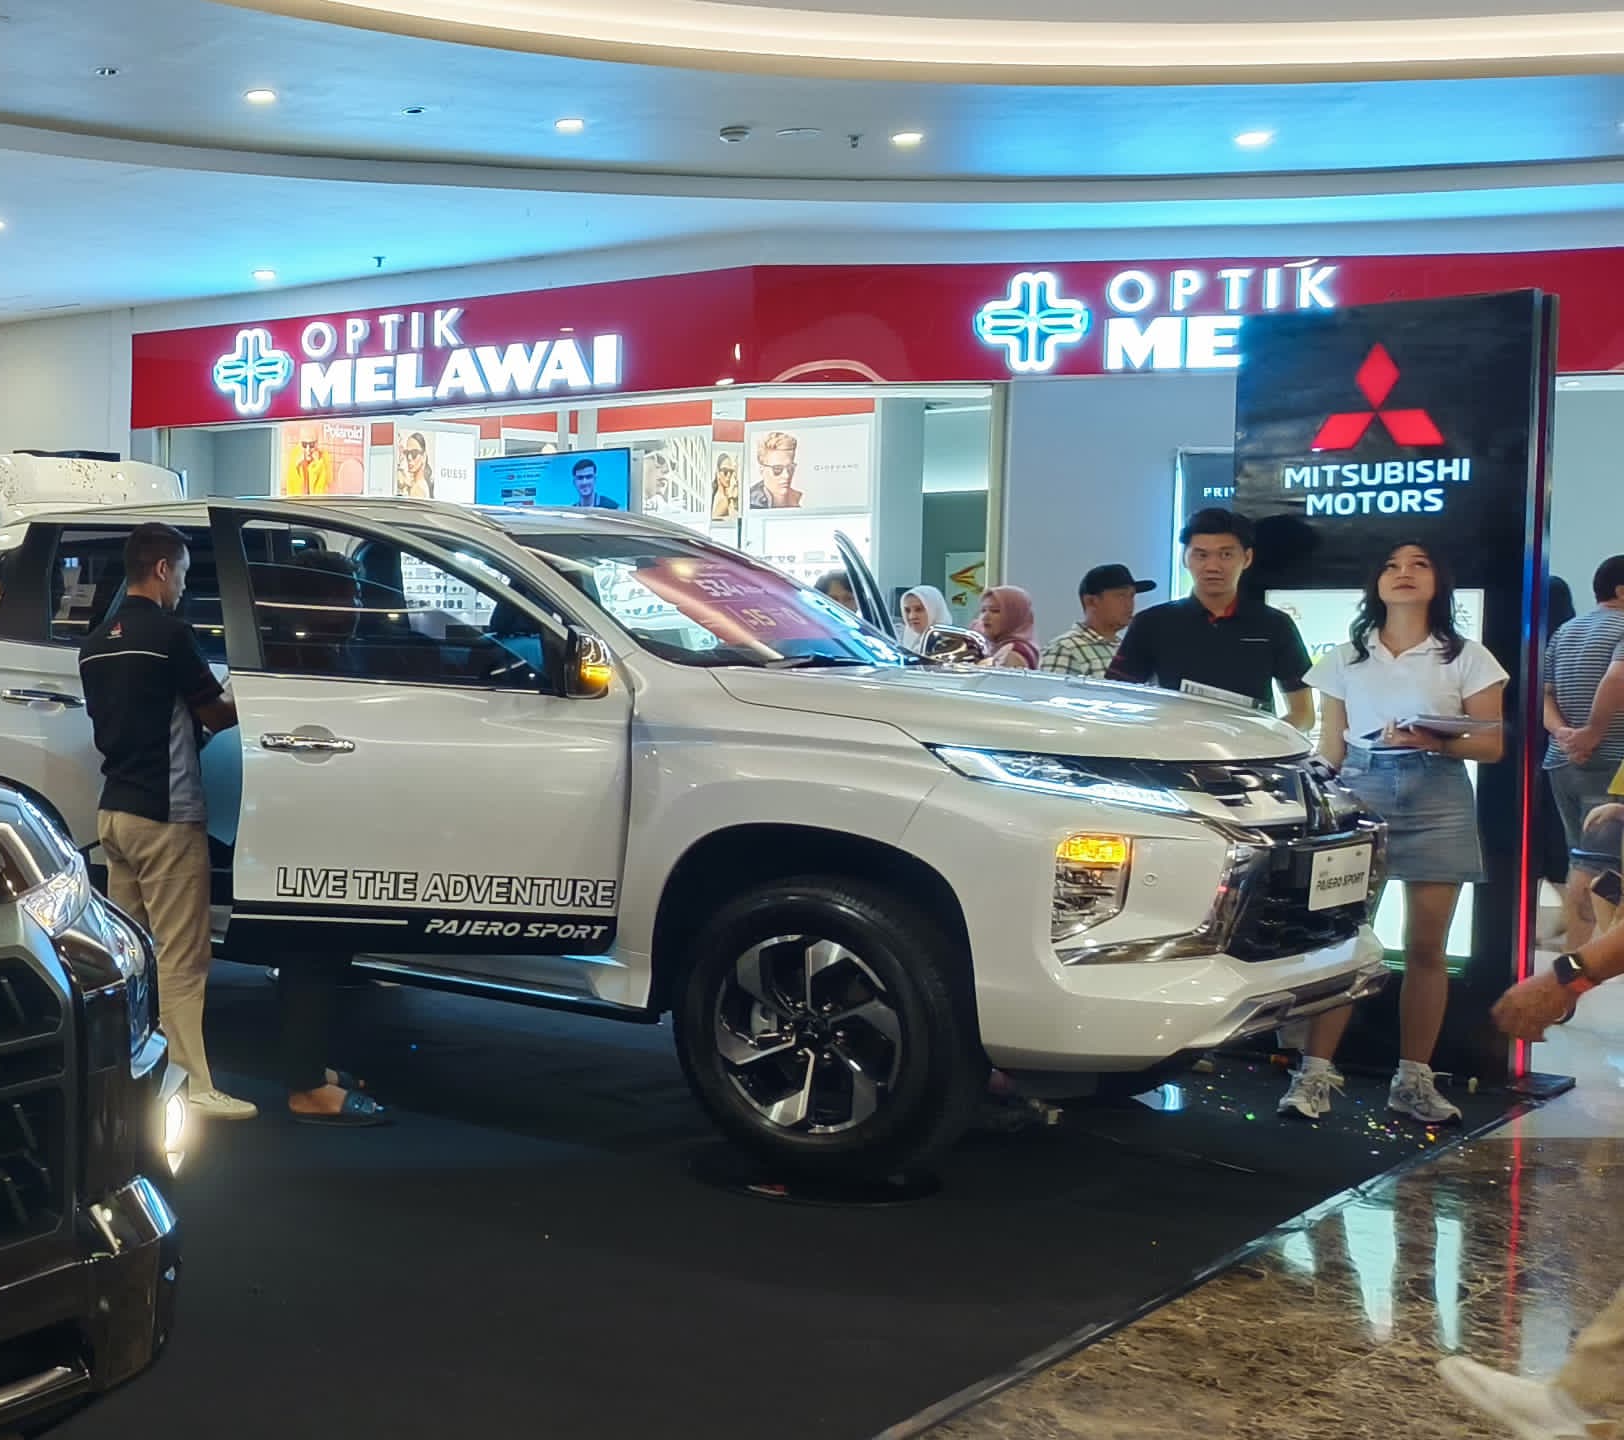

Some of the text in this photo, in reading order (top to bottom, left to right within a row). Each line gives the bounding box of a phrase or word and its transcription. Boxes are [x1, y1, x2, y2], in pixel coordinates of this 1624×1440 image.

[1105, 266, 1337, 313] OPTIK
[301, 307, 464, 359] OPTIK
[300, 333, 623, 410] MELAWAI
[1284, 458, 1470, 489] MITSUBISHI
[1306, 488, 1444, 516] MOTORS
[276, 867, 616, 908] LIVE THE ADVENTURE
[424, 918, 609, 941] PAJERO SPORT
